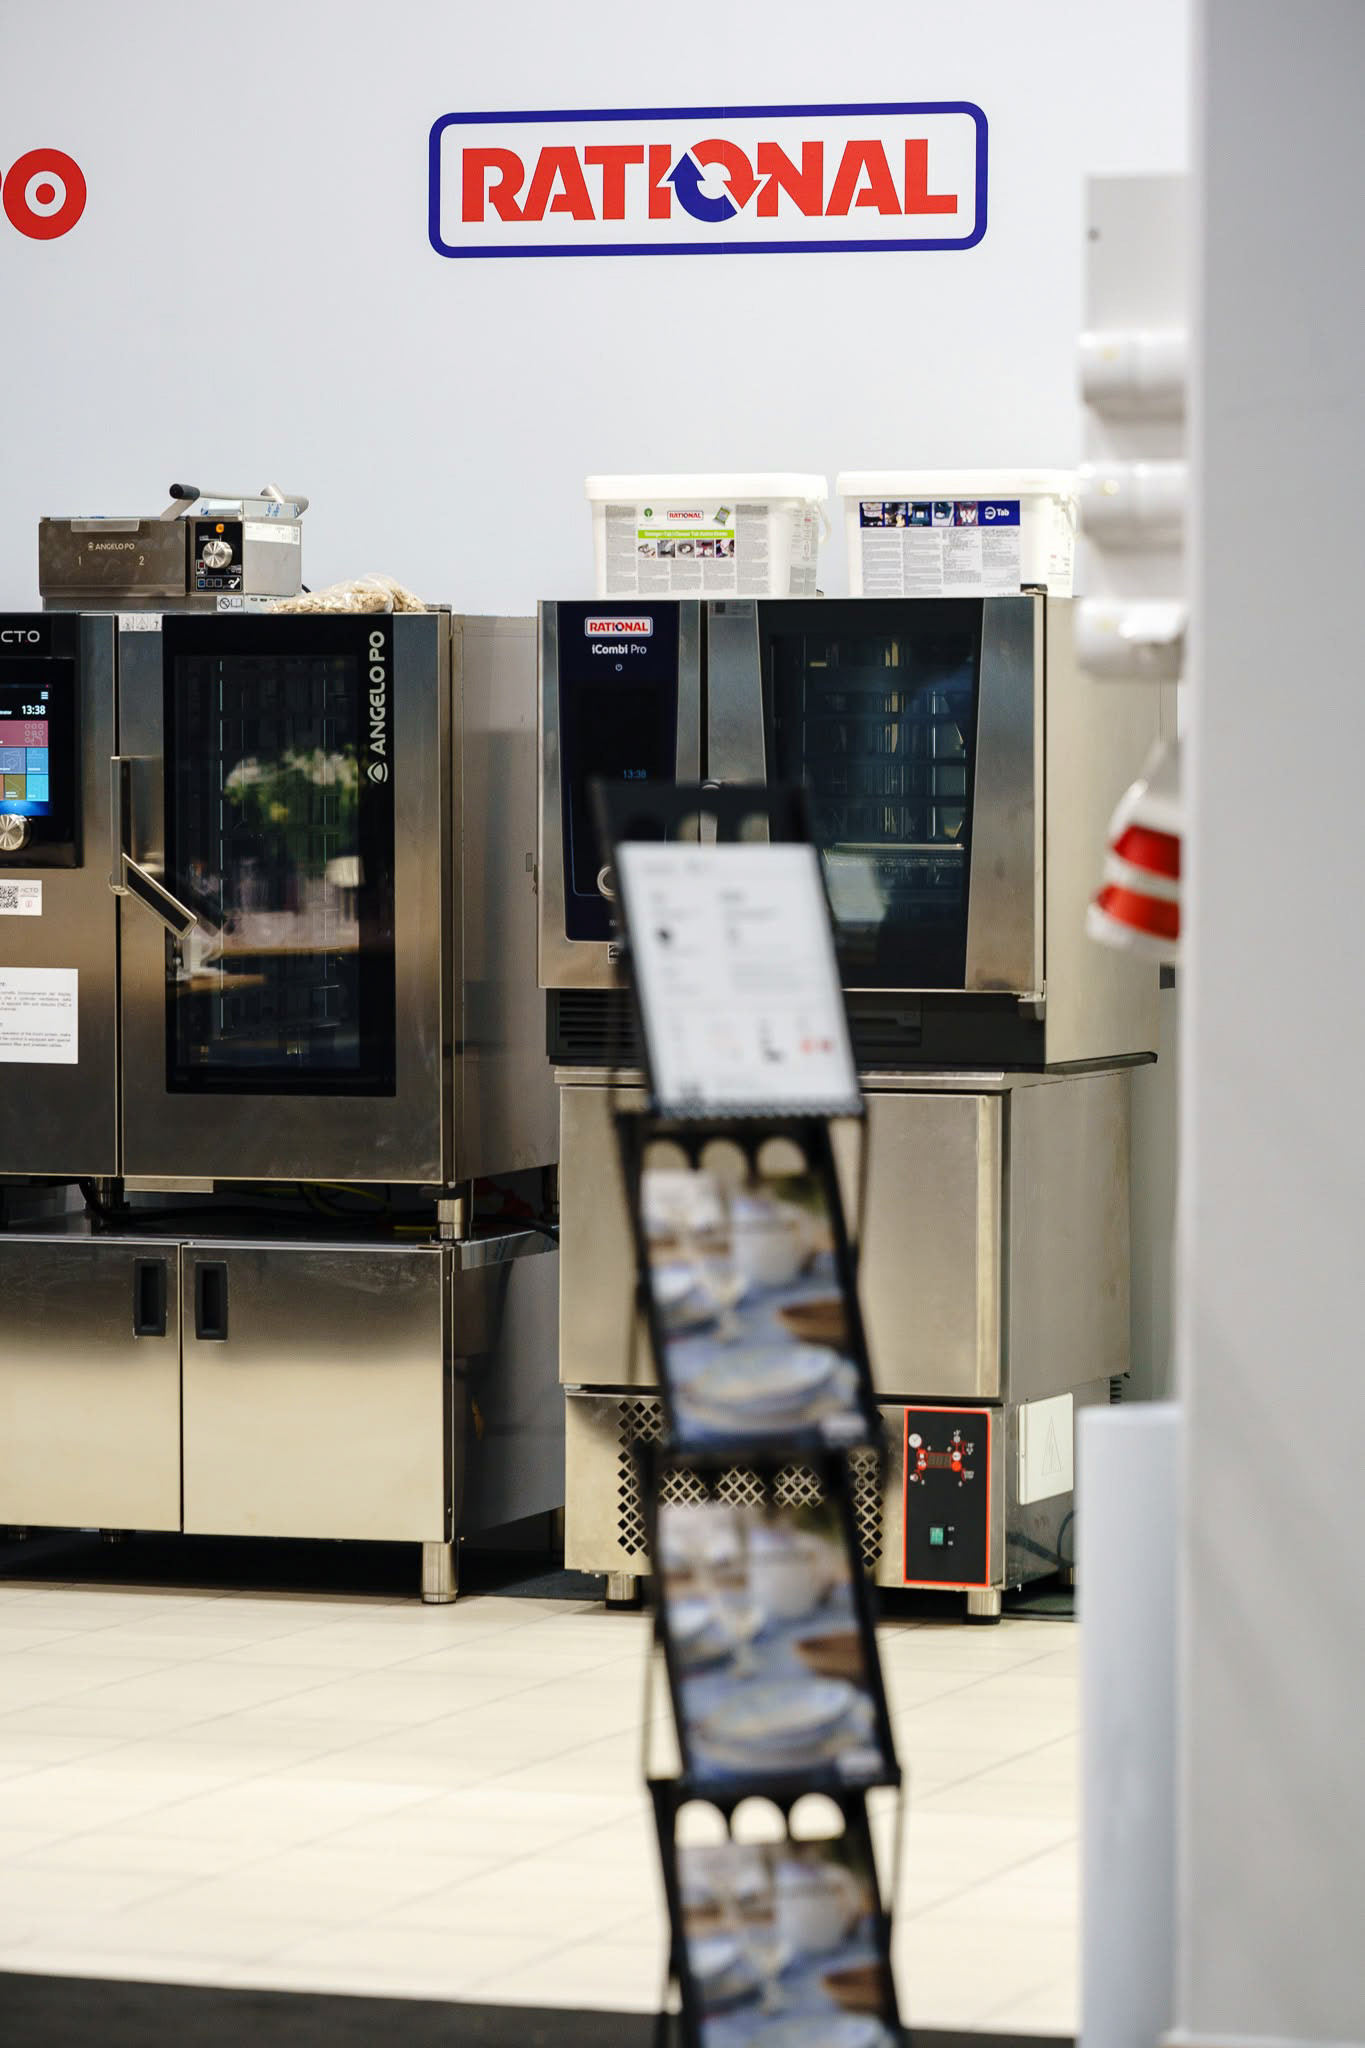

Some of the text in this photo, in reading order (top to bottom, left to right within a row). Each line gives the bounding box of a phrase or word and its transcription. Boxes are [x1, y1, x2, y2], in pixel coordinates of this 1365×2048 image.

[462, 138, 958, 223] RATIONAL
[0, 147, 87, 240] O
[95, 542, 135, 551] ANGELO PO
[138, 556, 145, 566] 2
[589, 621, 649, 632] RATIONAL
[592, 644, 648, 655] iCombi Pro
[369, 630, 386, 756] ANGELO PO
[21, 704, 46, 715] 13:38
